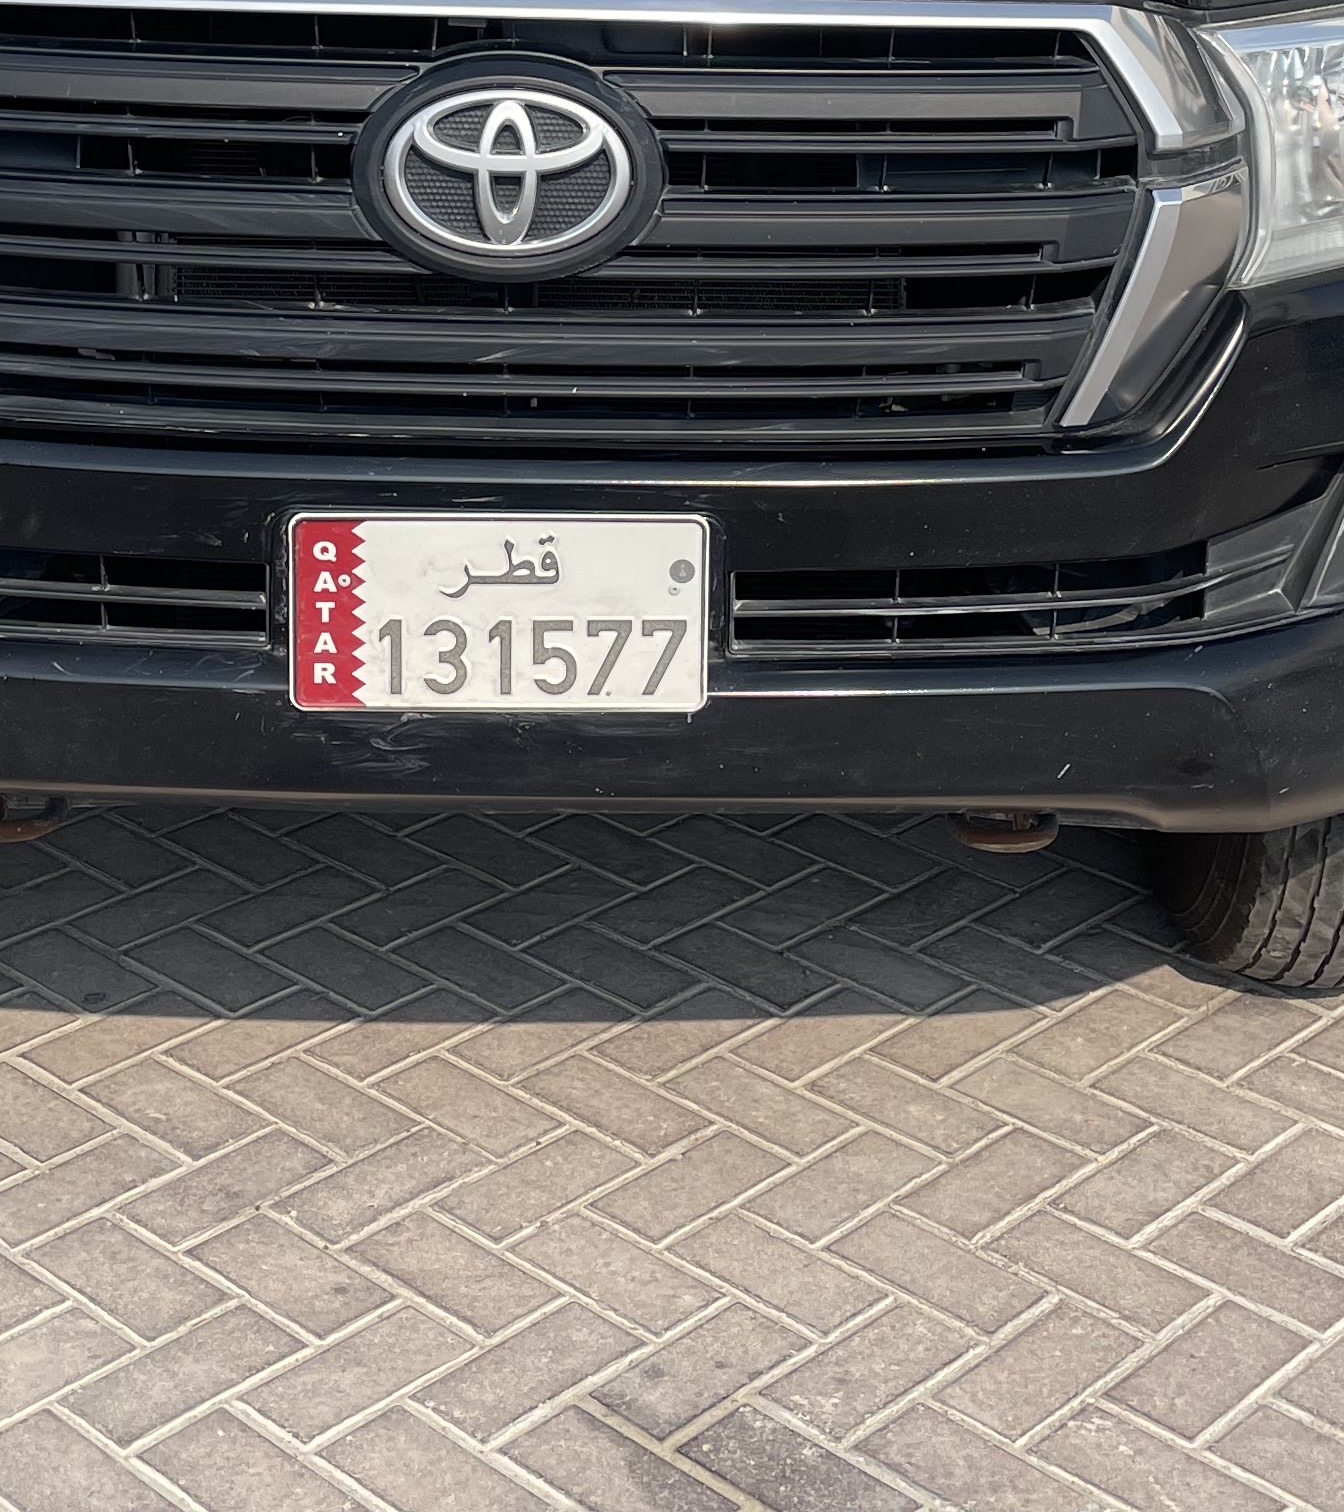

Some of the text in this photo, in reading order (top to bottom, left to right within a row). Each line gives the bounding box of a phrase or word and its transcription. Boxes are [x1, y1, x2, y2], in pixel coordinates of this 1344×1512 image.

[439, 534, 560, 600] قطر
[312, 540, 337, 685] QATAR
[378, 617, 688, 696] 131577
